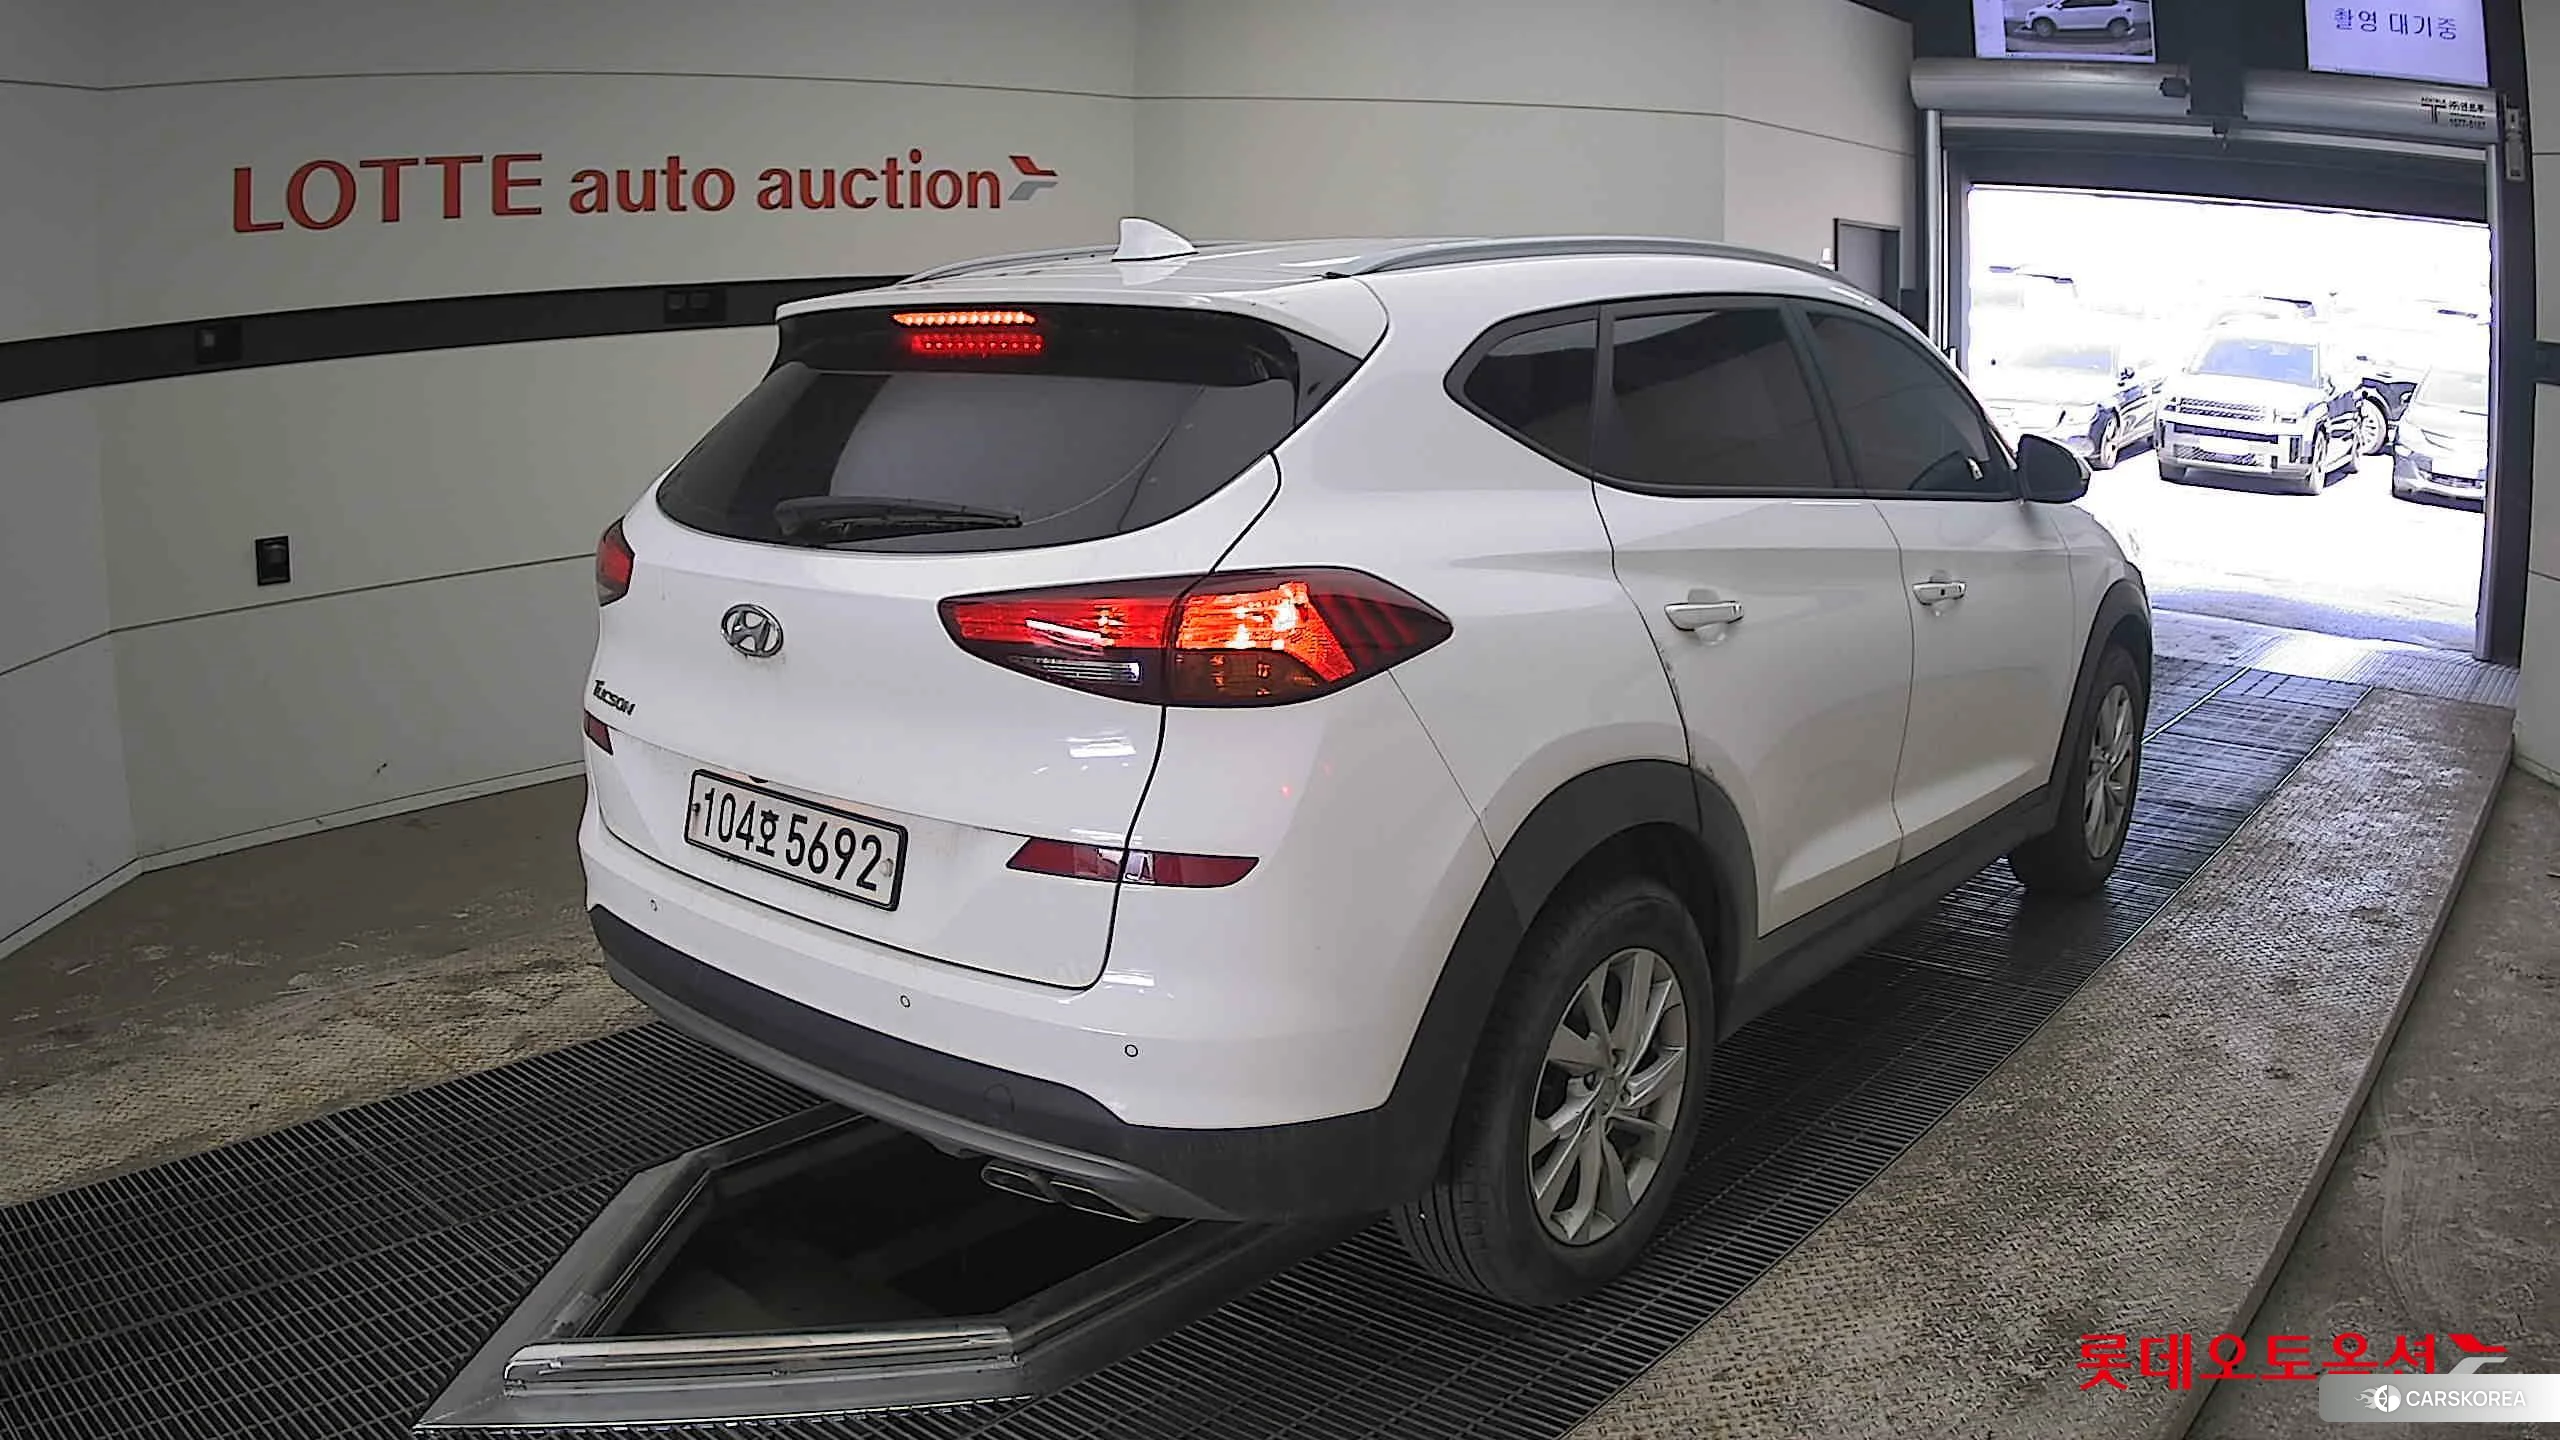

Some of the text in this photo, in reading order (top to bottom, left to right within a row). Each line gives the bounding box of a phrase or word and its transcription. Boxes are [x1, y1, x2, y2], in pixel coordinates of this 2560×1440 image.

[2334, 7, 2458, 41] 촬영 대기중
[234, 148, 1002, 233] LOTTE auto auction
